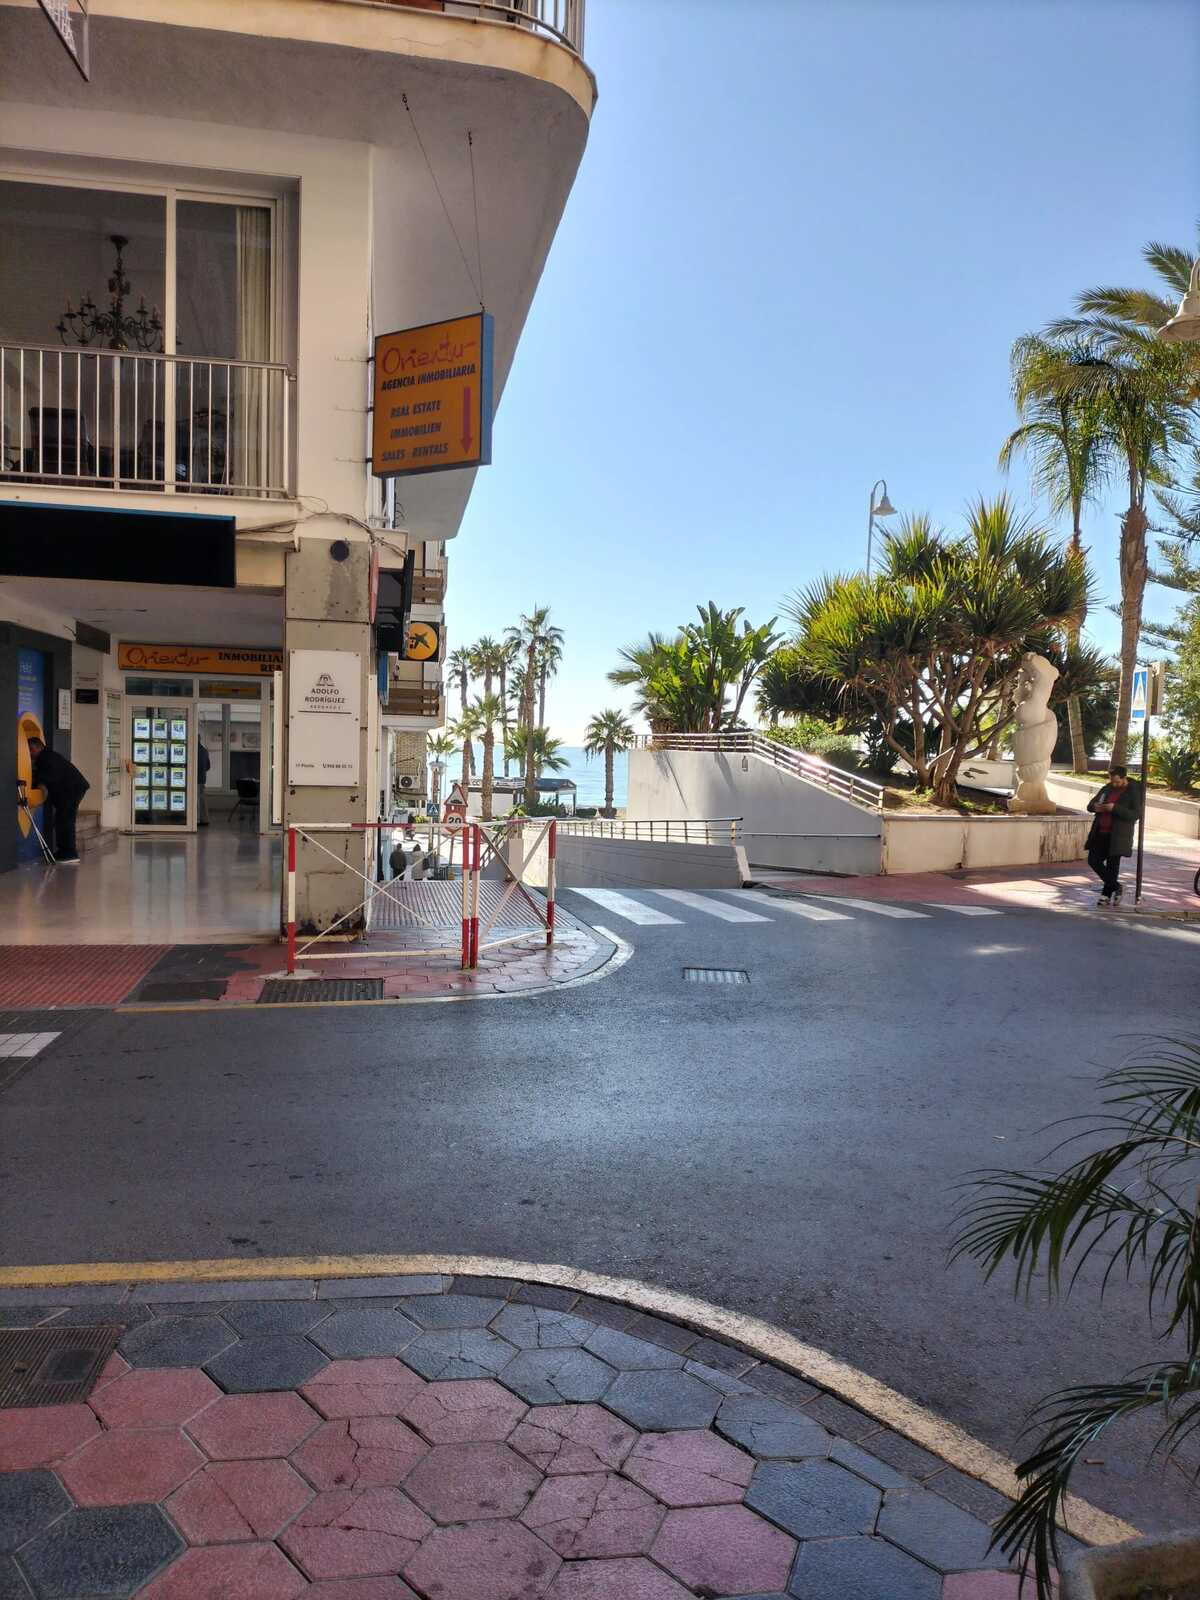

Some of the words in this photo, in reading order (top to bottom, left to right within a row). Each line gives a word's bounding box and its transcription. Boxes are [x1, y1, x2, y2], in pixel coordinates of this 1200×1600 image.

[381, 375, 416, 391] AGENCIA
[417, 363, 477, 385] INMOBILIARIA
[390, 404, 410, 418] REAL
[412, 400, 441, 415] ESTATE
[390, 422, 442, 440] IMMOBILIEN
[381, 448, 406, 462] SALES
[411, 443, 449, 458] RENTALS
[304, 695, 345, 703] RODRÍGUEZ
[448, 816, 461, 824] 20
